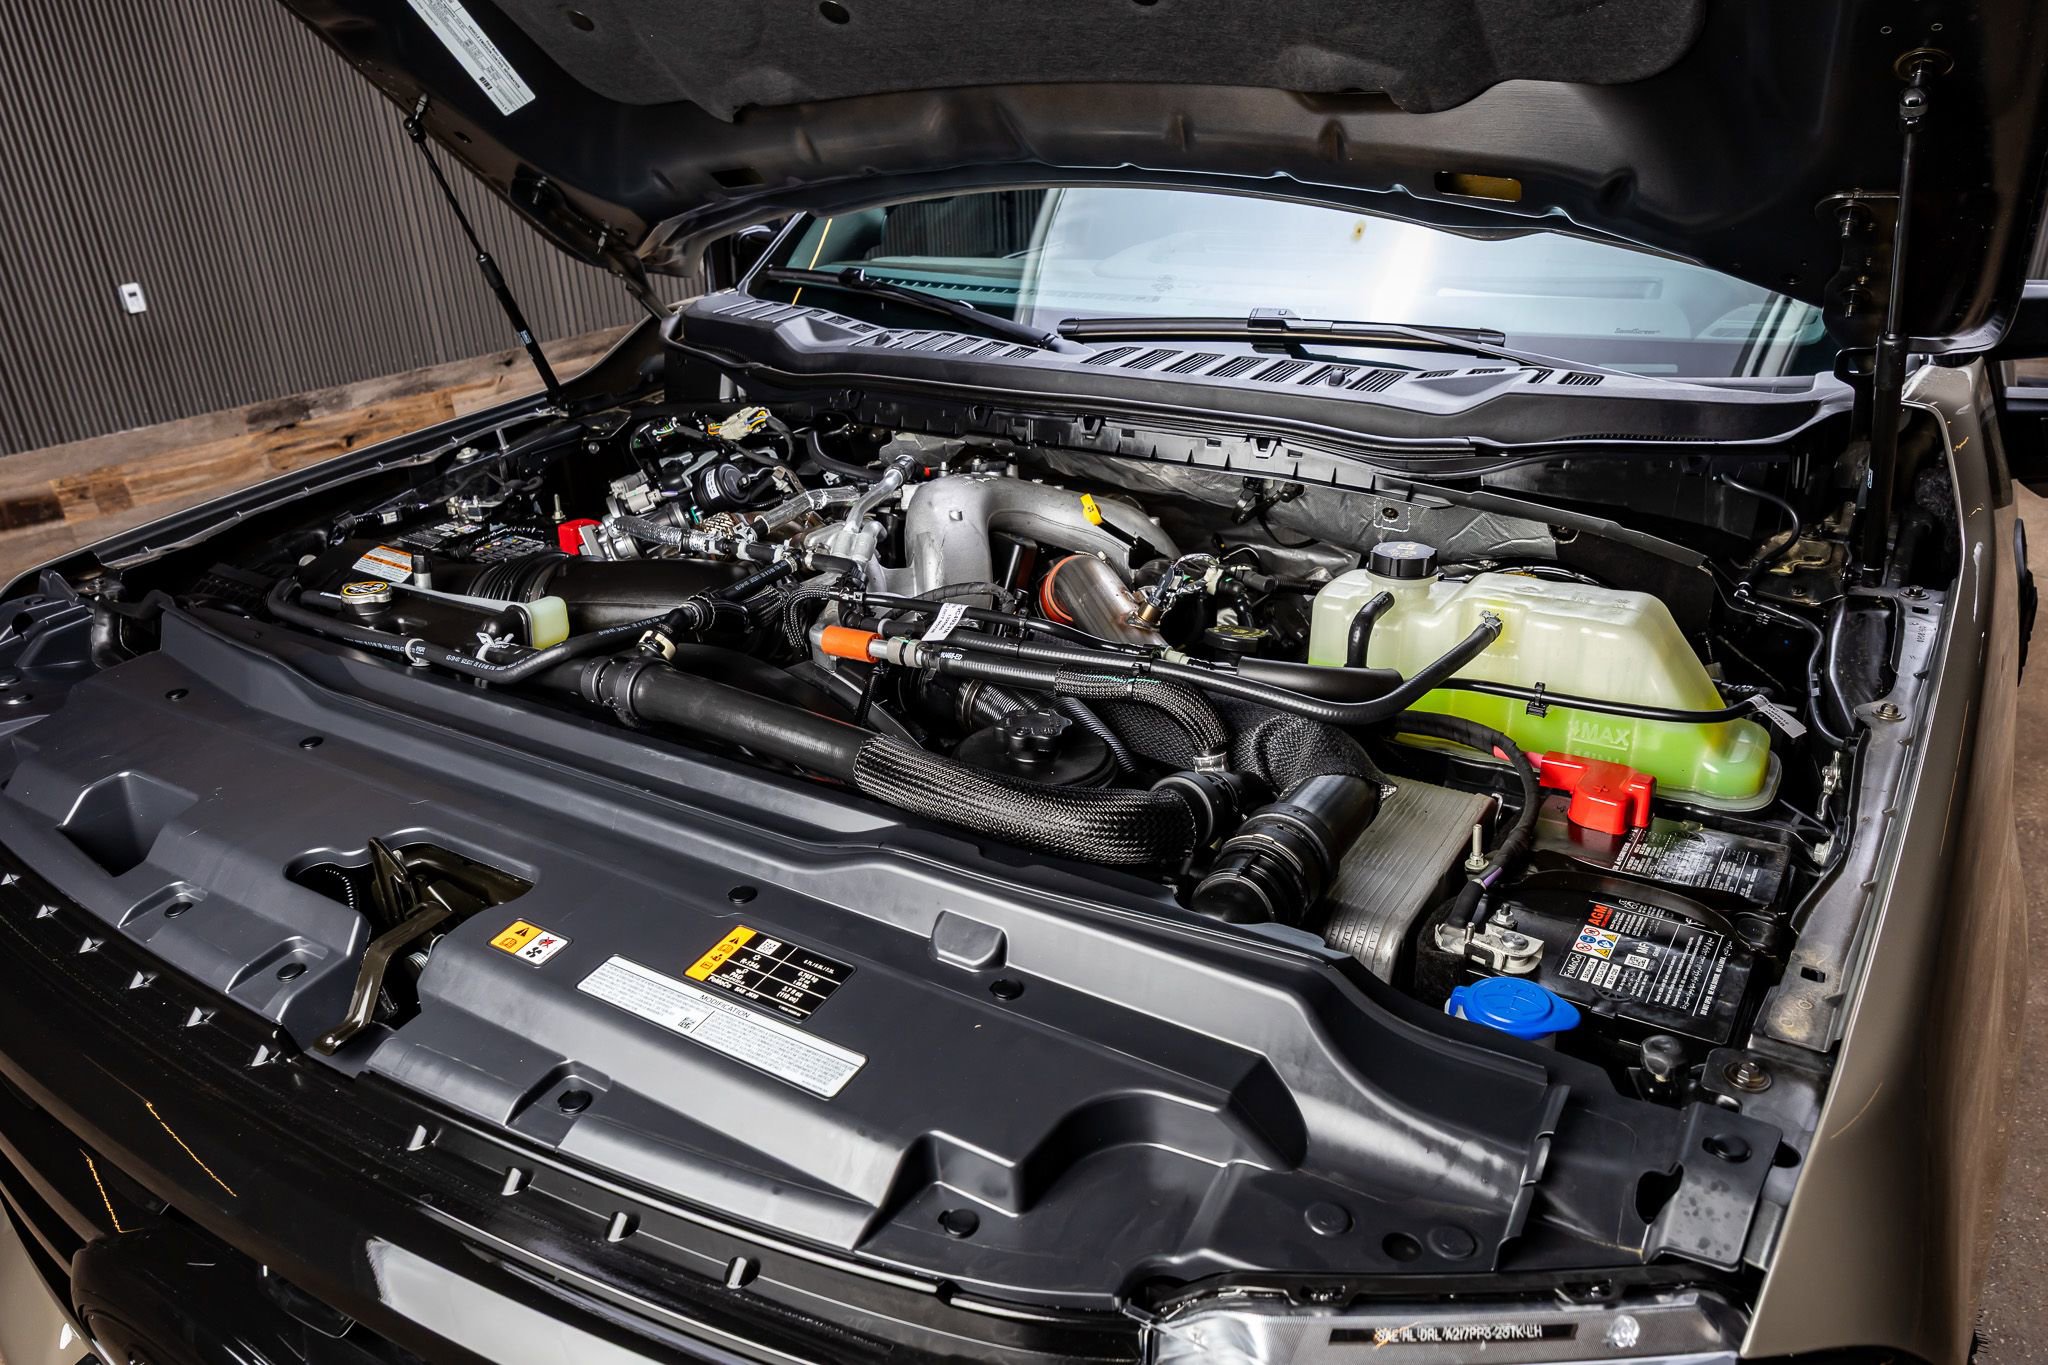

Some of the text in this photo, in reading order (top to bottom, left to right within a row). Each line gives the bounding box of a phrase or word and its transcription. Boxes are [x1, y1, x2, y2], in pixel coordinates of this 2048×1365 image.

[1581, 721, 1631, 746] MAX
[1588, 904, 1608, 926] AGM
[740, 958, 759, 969] R-134a
[1565, 954, 1583, 978] FoMoCo
[708, 976, 731, 988] FoMoCo
[699, 994, 751, 1018] MODIFICATION
[1420, 1327, 1442, 1341] DRL
